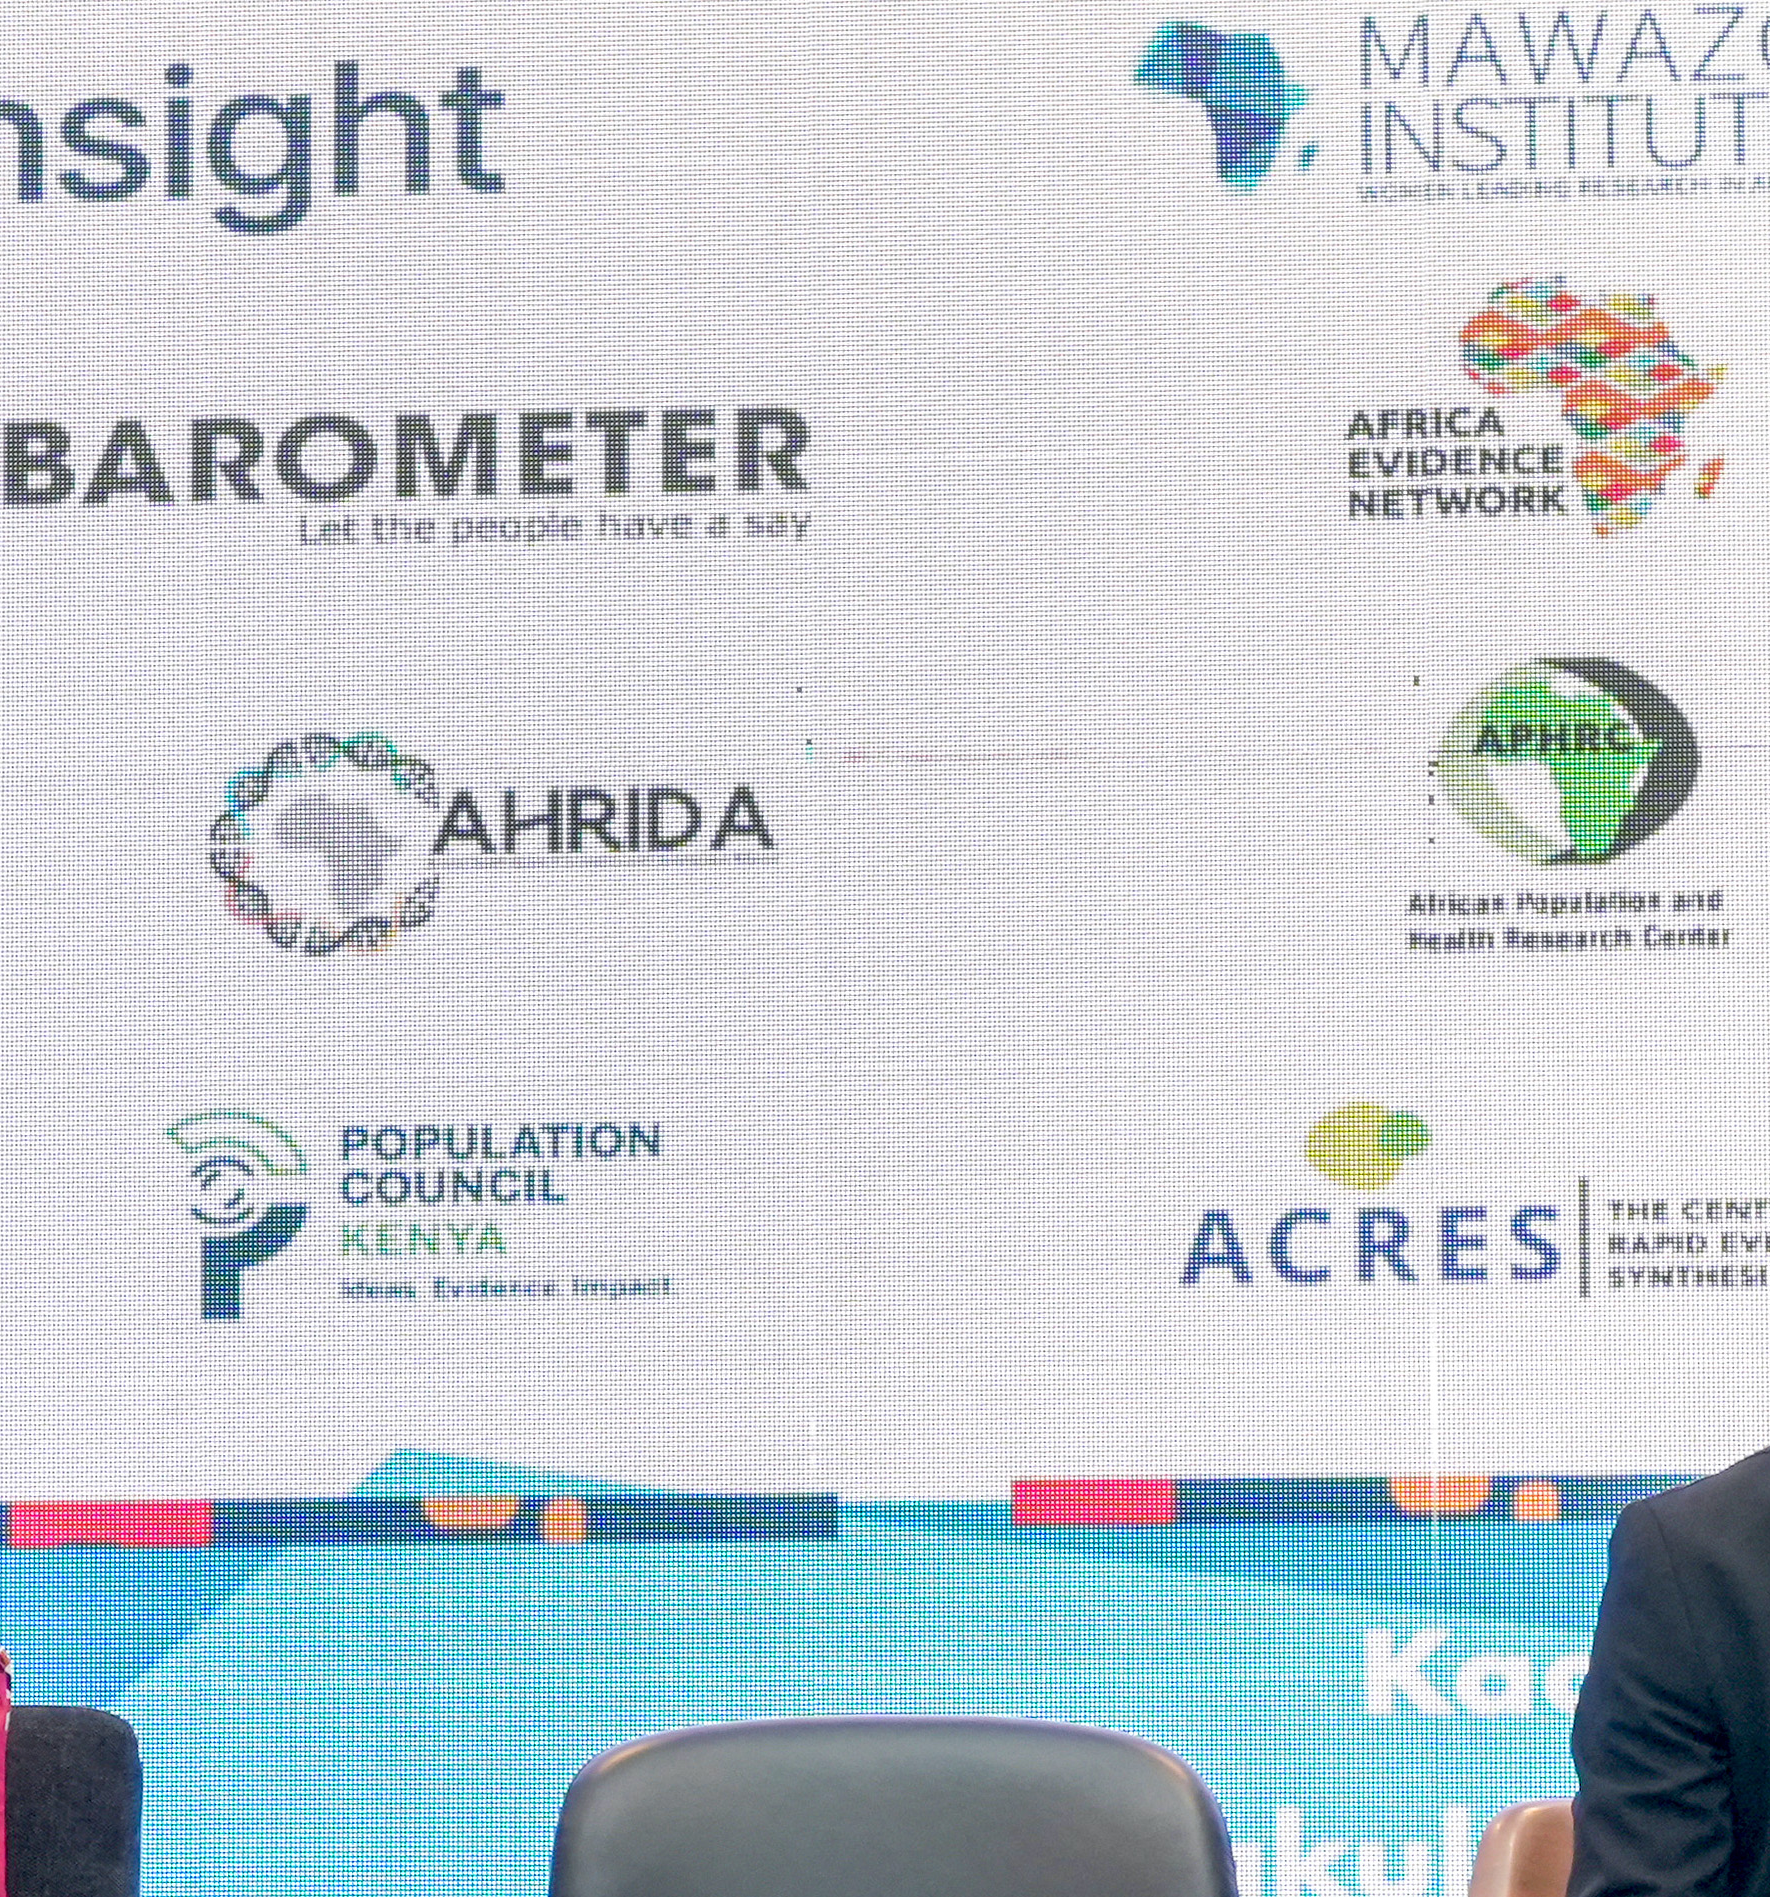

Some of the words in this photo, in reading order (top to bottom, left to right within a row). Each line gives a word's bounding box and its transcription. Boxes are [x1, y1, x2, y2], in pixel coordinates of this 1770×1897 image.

[1345, 406, 1504, 440] AFRICA
[1347, 444, 1564, 480] EVIDENCE
[1347, 484, 1567, 518] NETWORK
[297, 513, 358, 547] Let
[371, 512, 435, 545] the
[449, 511, 583, 549] people
[597, 508, 693, 542] have
[706, 513, 728, 540] a
[744, 511, 811, 545] say
[1473, 720, 1631, 755] APHRC
[431, 784, 776, 854] AHRIDA
[1407, 890, 1505, 914] African
[1516, 889, 1661, 917] Population
[1671, 889, 1724, 912] and
[1407, 927, 1495, 953] Health
[1503, 926, 1631, 951] Research
[1643, 924, 1731, 950] Center
[340, 1123, 663, 1162] POPULATION
[339, 1168, 567, 1205] COUNCIL
[1607, 1199, 1668, 1221] THE
[340, 1222, 508, 1257] KENYA
[1180, 1203, 1560, 1286] ACRES
[1608, 1232, 1708, 1254] RAPID
